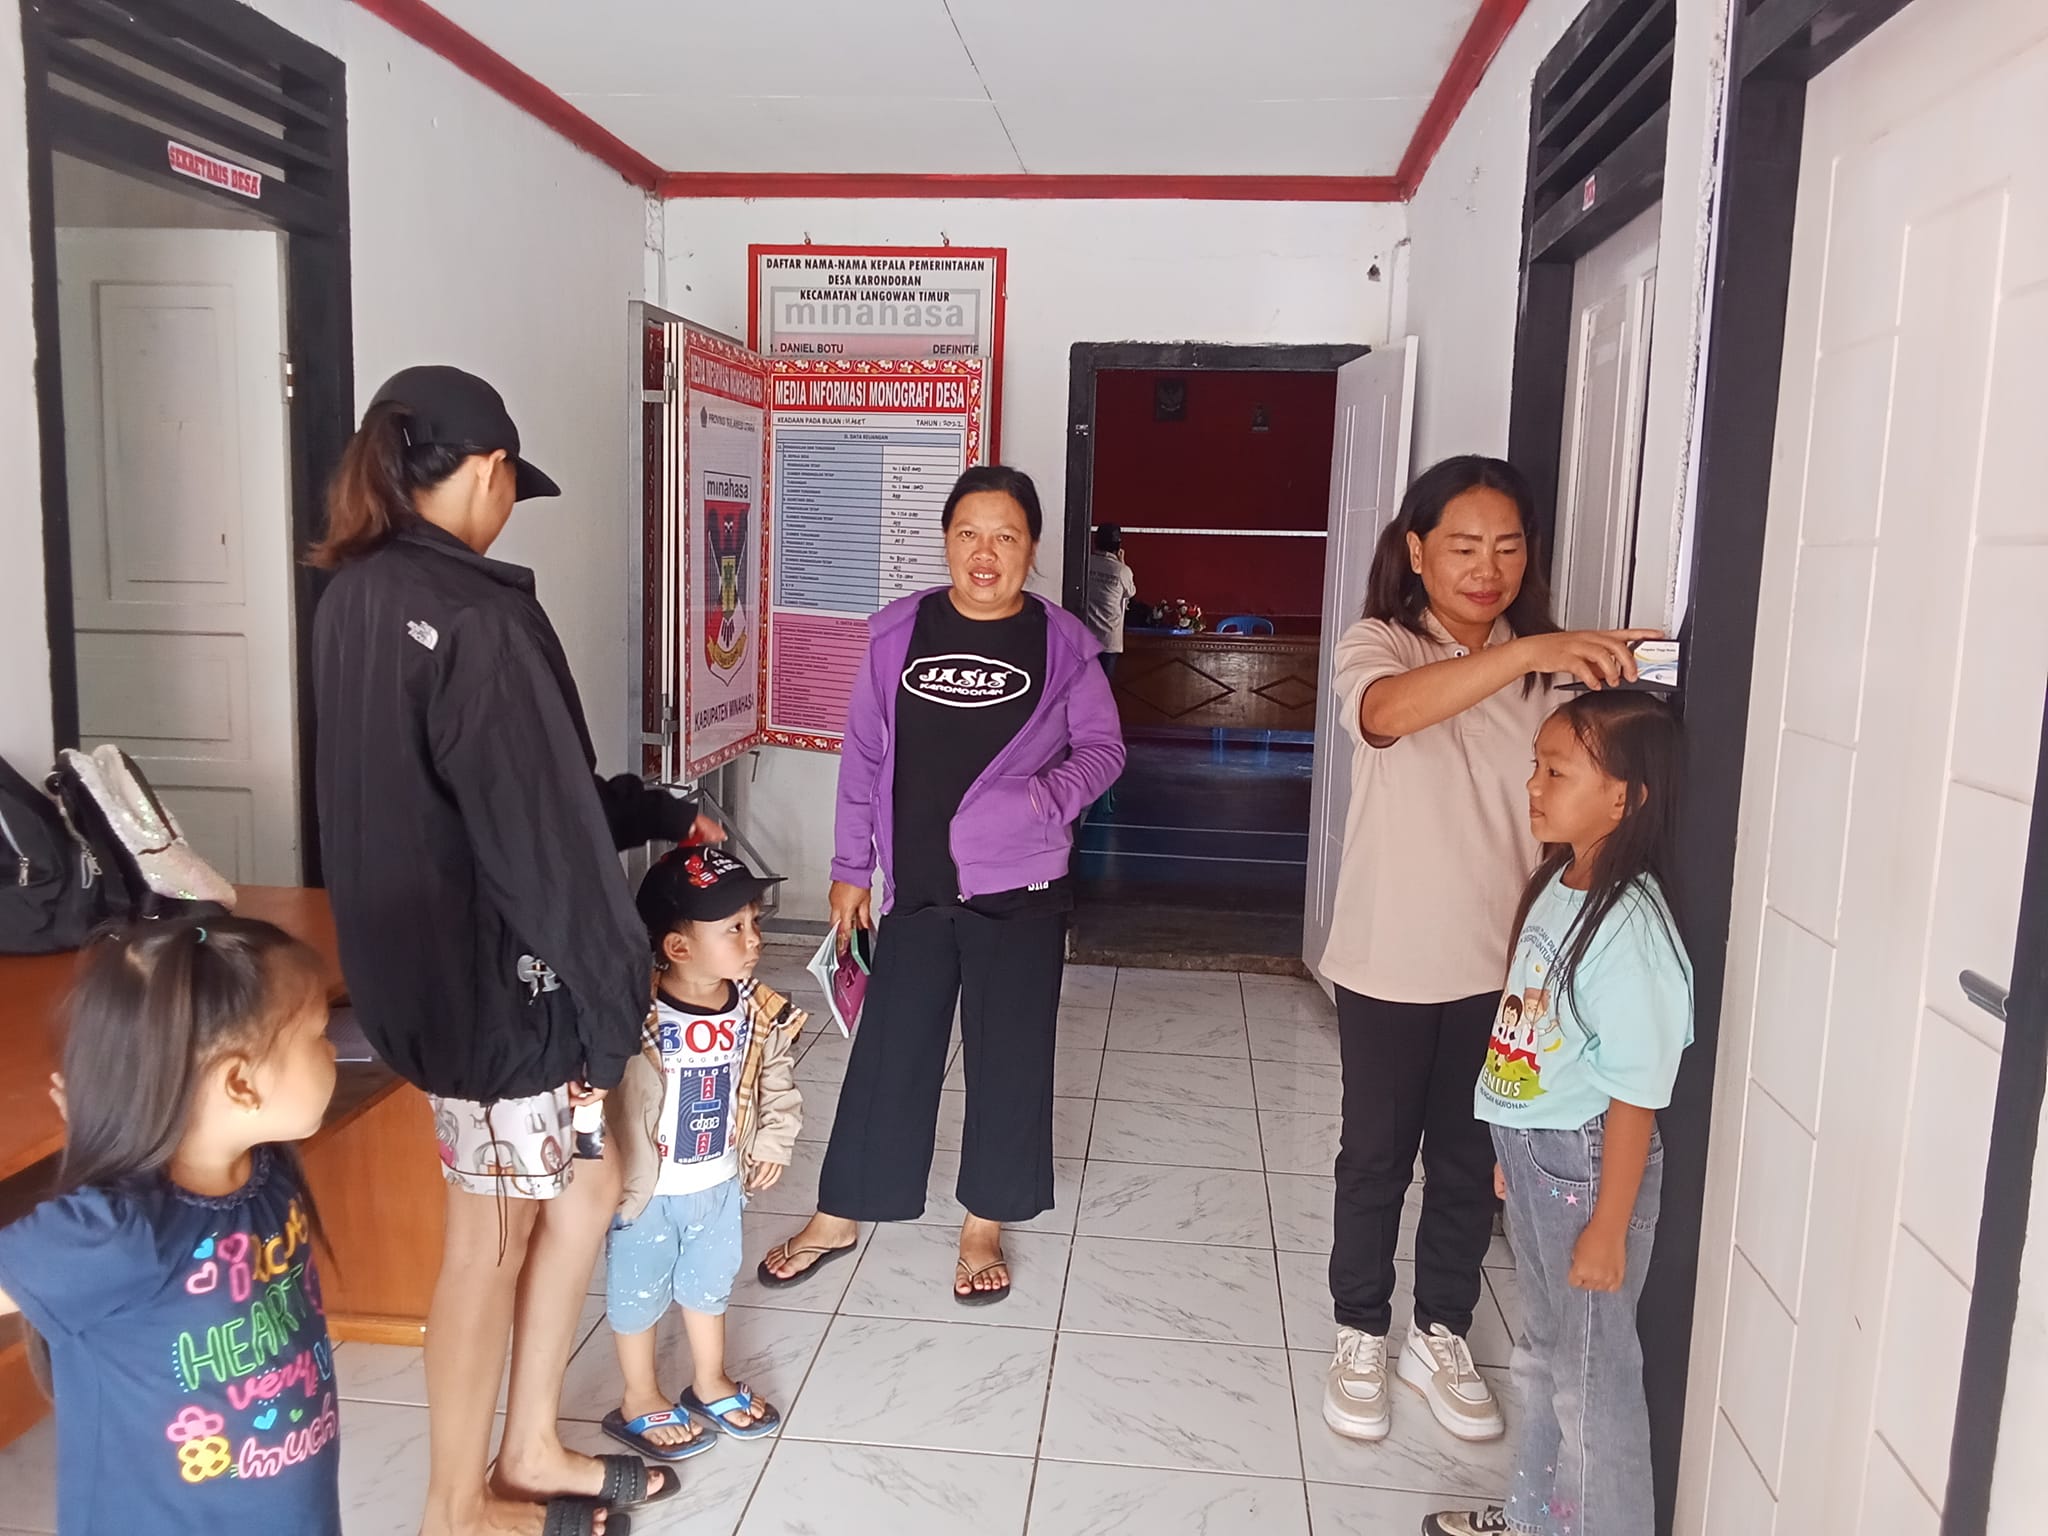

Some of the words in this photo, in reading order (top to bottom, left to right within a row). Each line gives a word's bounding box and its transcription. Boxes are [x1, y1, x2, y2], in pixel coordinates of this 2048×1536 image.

[169, 145, 228, 186] SEKRETARIS
[231, 169, 259, 195] DESA
[766, 258, 801, 270] DAFTAR
[804, 258, 868, 271] NAMA-NAMA
[870, 259, 906, 271] KEPALA
[909, 260, 985, 272] PEMERINTAHAN
[828, 275, 851, 286] DESA
[854, 275, 922, 287] KARONDORAN
[800, 290, 857, 301] KECAMATAN
[860, 290, 916, 302] LANGOWAN
[919, 291, 950, 303] TIMUR
[785, 301, 964, 327] minahasa
[780, 342, 814, 353] DANIEL
[817, 343, 844, 354] BOTU
[933, 344, 979, 355] DEFINITIF
[775, 380, 807, 405] MEDIA
[809, 381, 866, 407] INFORMASI
[869, 382, 933, 408] MONOGRAFI
[936, 383, 965, 409] DESA
[822, 417, 841, 425] BULAN
[706, 478, 749, 499] minahasa
[919, 682, 1004, 697] KARONDORAN
[694, 702, 729, 733] KABUPATEN
[178, 1264, 306, 1391] HEART
[226, 1350, 319, 1411] very
[237, 1392, 339, 1481] much
